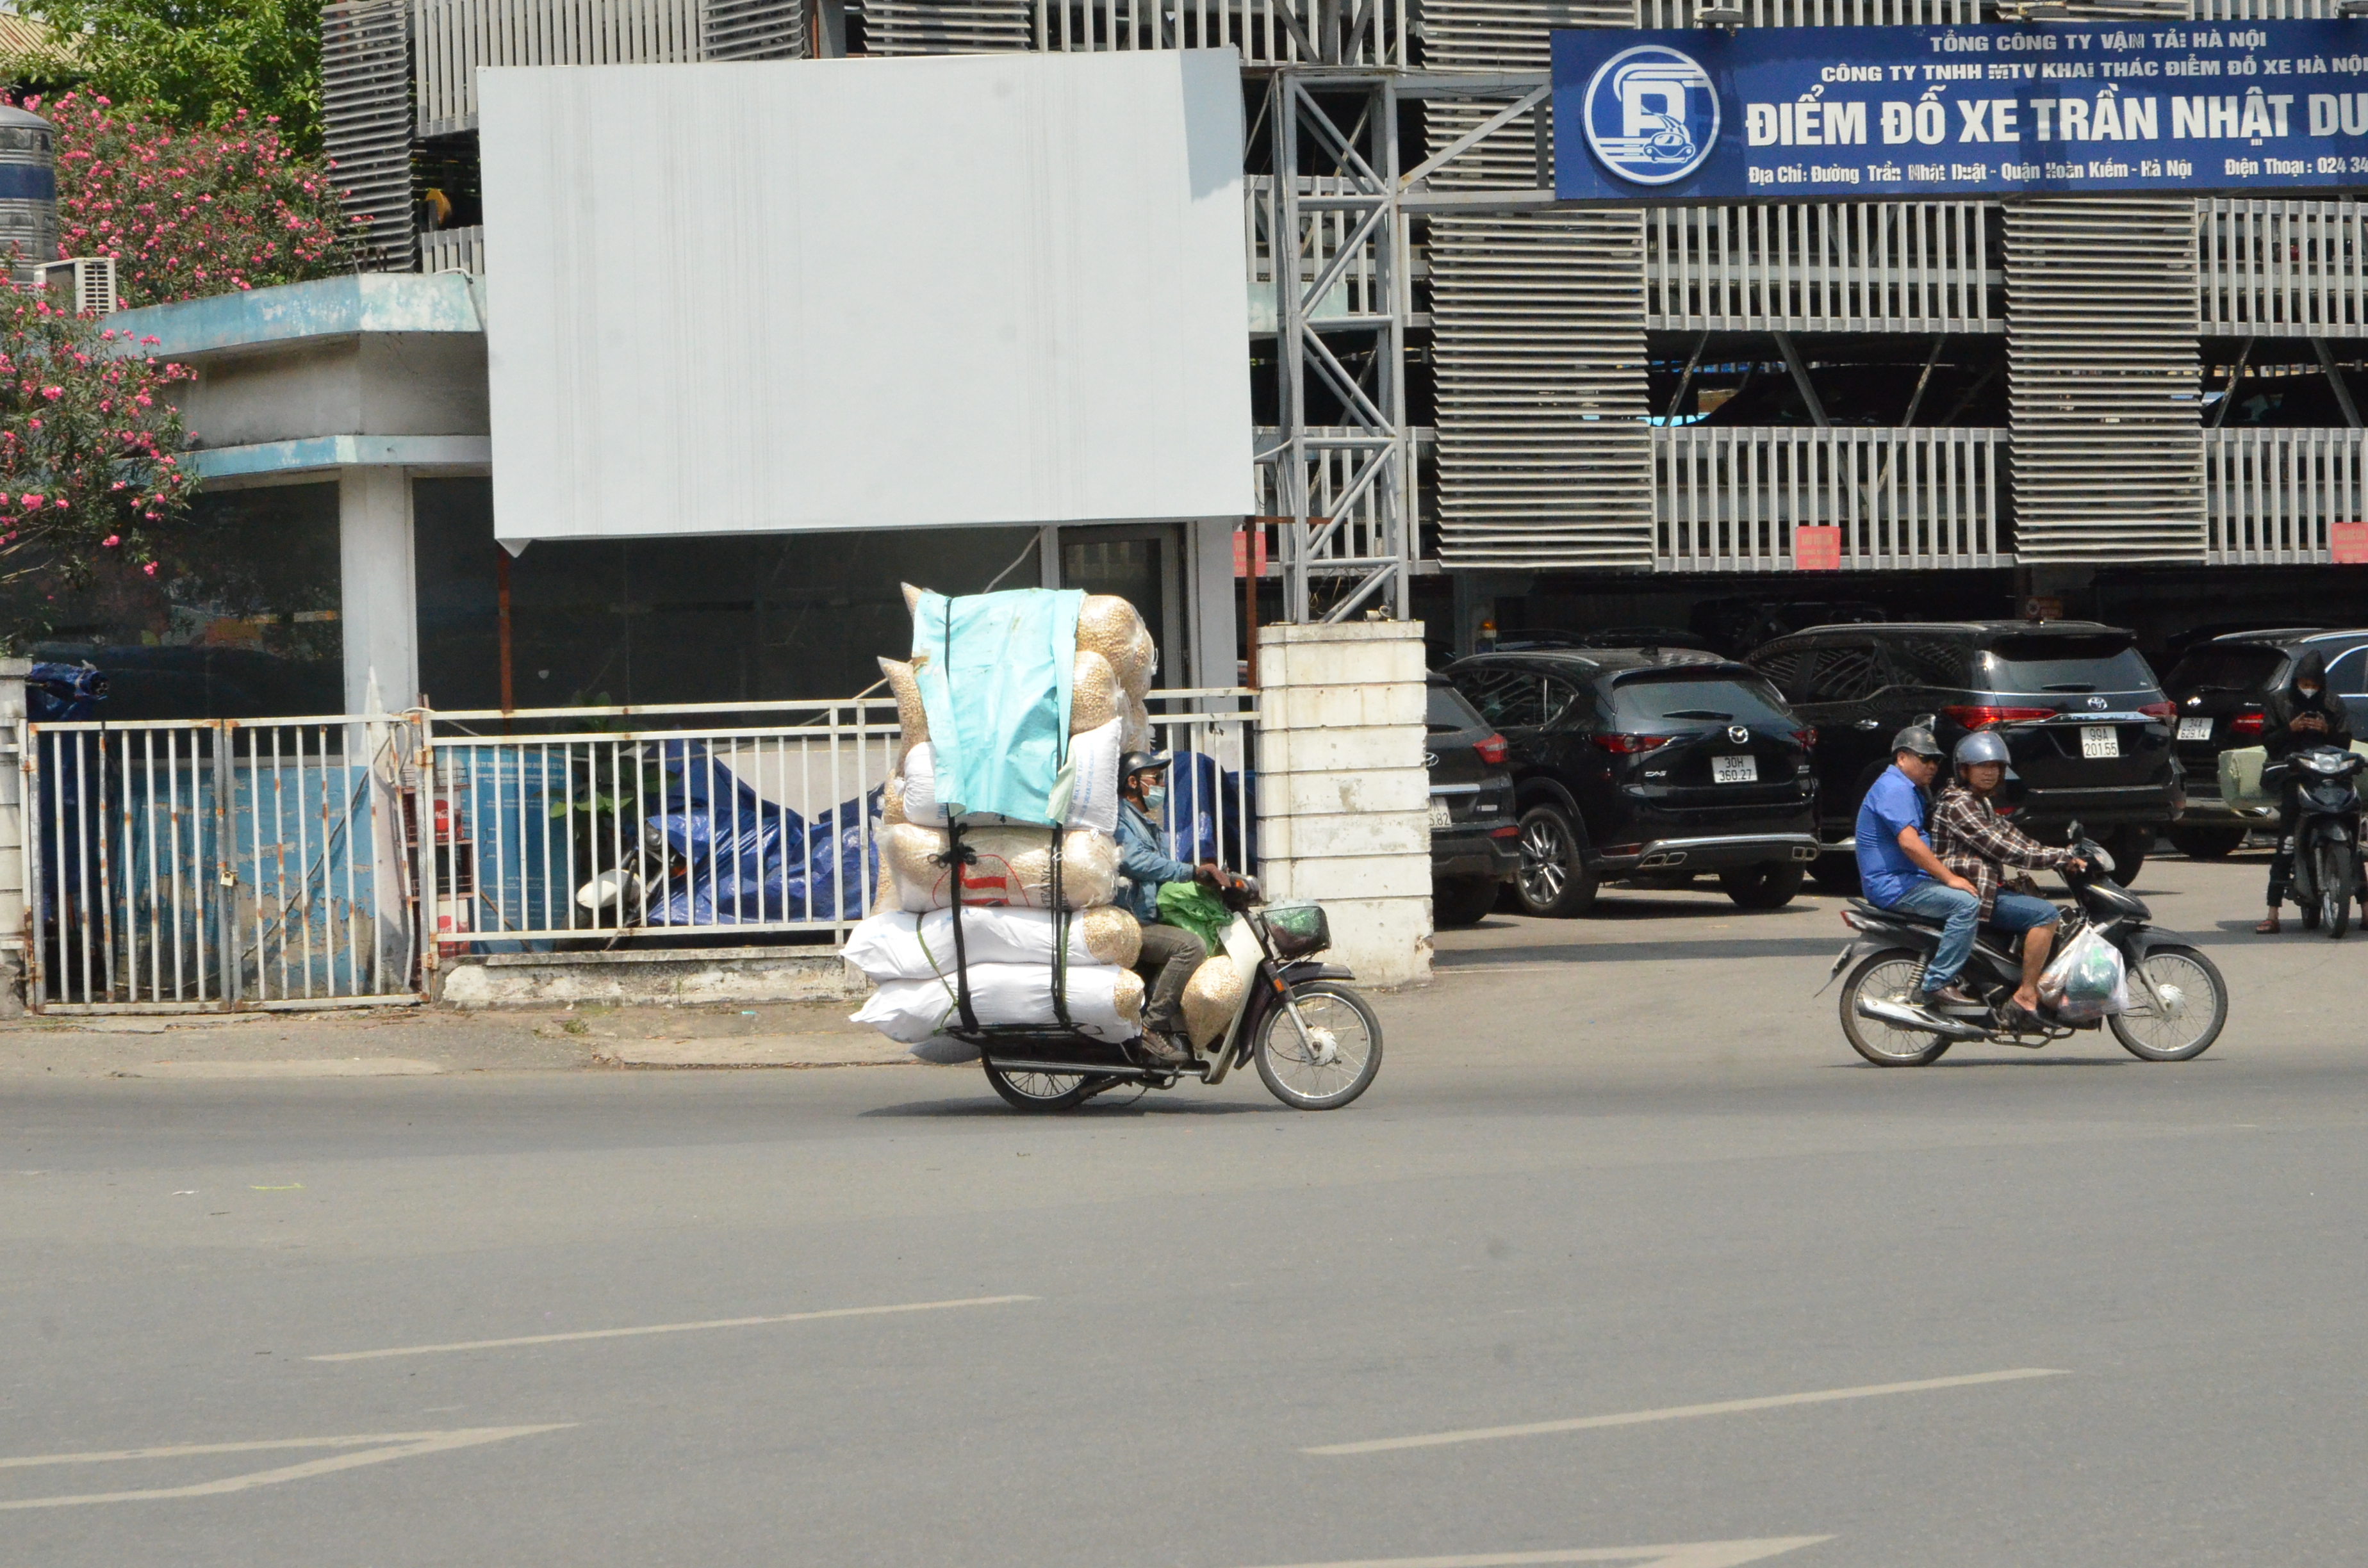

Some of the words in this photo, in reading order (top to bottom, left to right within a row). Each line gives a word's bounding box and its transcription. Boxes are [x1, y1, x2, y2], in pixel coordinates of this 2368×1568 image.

[1930, 29, 1989, 52] TỔNG
[1996, 32, 2057, 51] CÔNG
[2065, 34, 2092, 49] TY
[2101, 31, 2145, 52] VẬN
[2152, 28, 2186, 49] TẢI
[2192, 29, 2223, 48] HÀ
[2229, 29, 2266, 51] NỘI
[1821, 63, 1882, 82] CÔNG
[1889, 65, 1916, 81] TY
[1923, 64, 1981, 79] TNHH
[1988, 63, 2037, 79] MTV
[2042, 62, 2094, 78] KHAI
[2101, 57, 2158, 77] THÁC
[2165, 53, 2221, 76] ĐIỂM
[2227, 55, 2257, 75] ĐỖ
[2264, 59, 2292, 74] XE
[2297, 55, 2327, 74] HÀ
[2332, 54, 2368, 76] NỘI
[1745, 85, 1867, 146] ĐIỂM
[1880, 85, 1946, 145] ĐỖ
[1957, 99, 2019, 142] XE
[2030, 83, 2158, 142] TRẦN
[2171, 86, 2294, 145] NHẬT
[2308, 93, 2368, 137] DU
[1748, 166, 1774, 186] Địa
[1811, 164, 1859, 184] Đường
[1867, 160, 1901, 181] Trần
[1908, 164, 1946, 184] Nhật
[2002, 162, 2040, 182] Quận
[2089, 158, 2128, 178] Kiếm
[2141, 158, 2162, 177] Hà
[2167, 159, 2192, 179] Nội
[2225, 158, 2258, 178] Điện
[2317, 157, 2346, 174] 024
[2090, 728, 2109, 741] 99A
[2085, 742, 2117, 756] 201.55
[1725, 757, 1743, 768] 30H
[1719, 769, 1752, 781] 360.27
